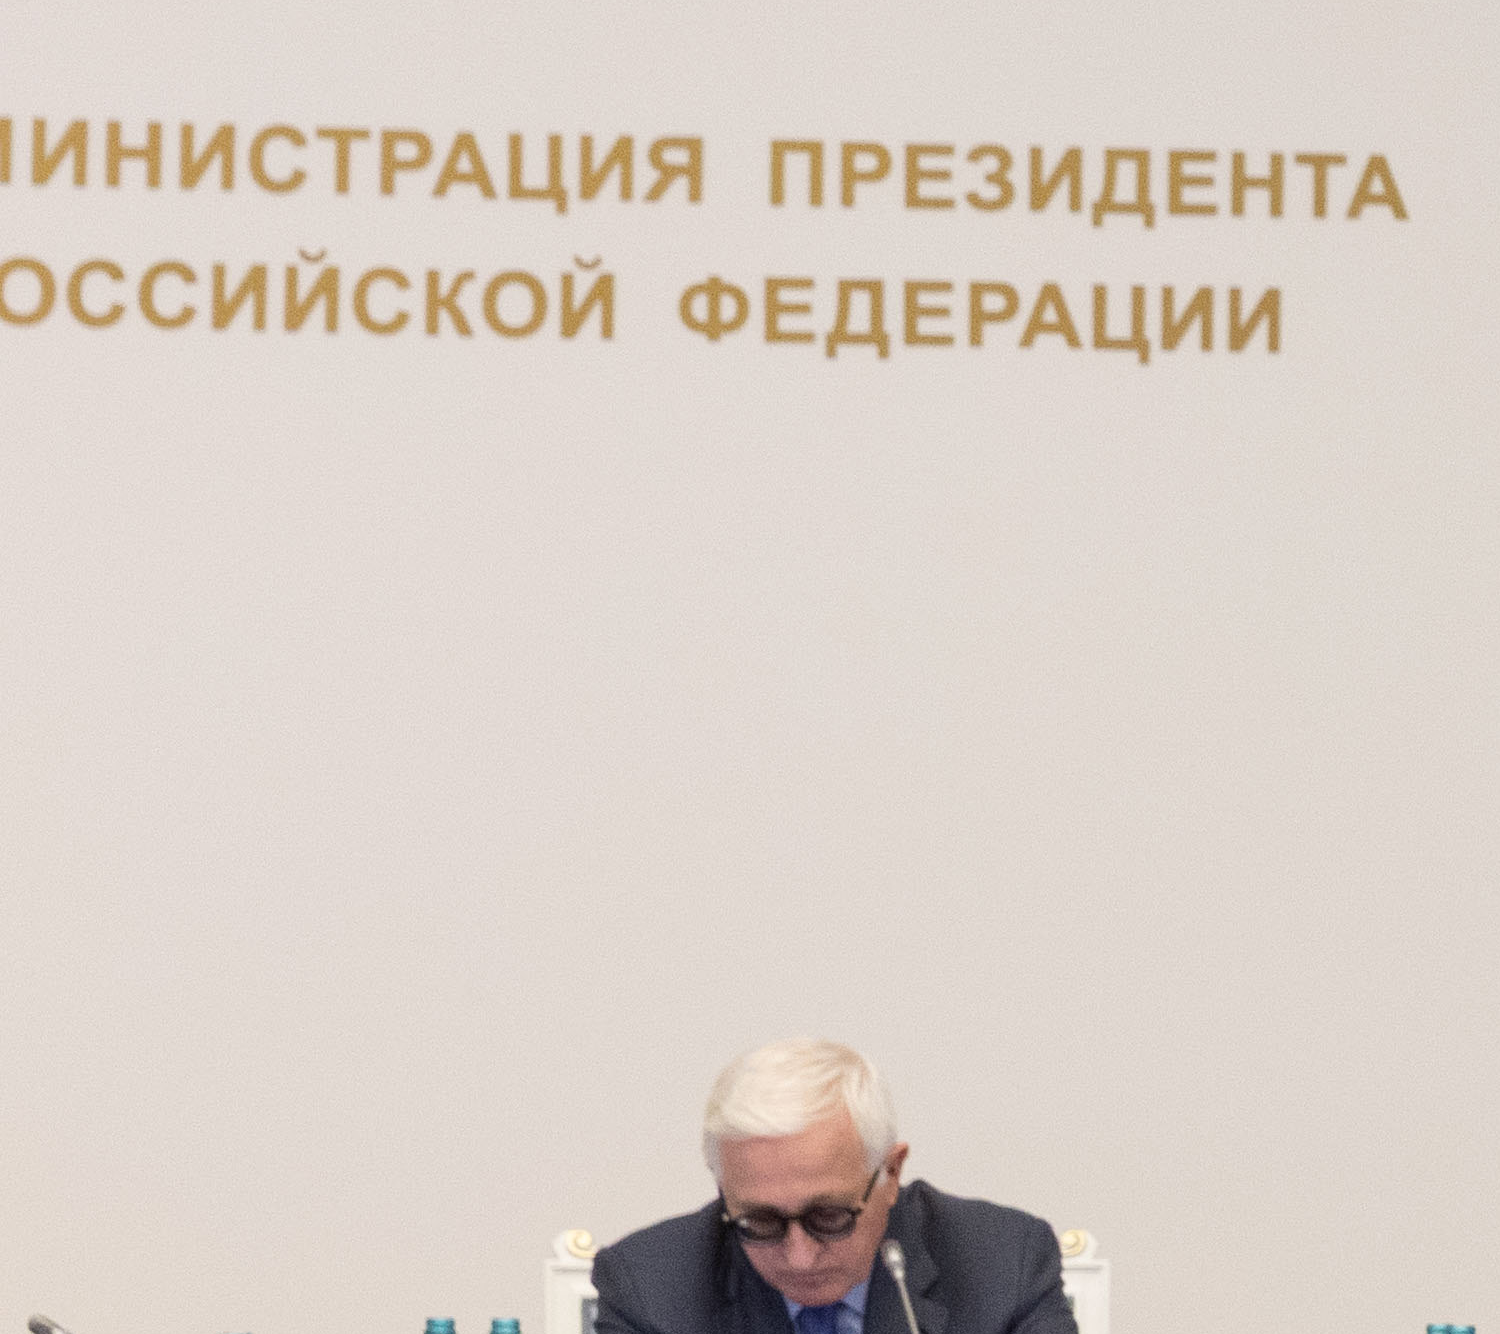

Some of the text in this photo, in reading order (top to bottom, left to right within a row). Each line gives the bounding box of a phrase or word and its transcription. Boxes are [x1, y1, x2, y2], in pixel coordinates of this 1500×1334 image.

[0, 117, 1408, 228] ИНИСТРАЦИЯ ПРЕЗИДЕНТА
[0, 249, 1282, 364] ОССИЙСКОЙ ФЕДЕРАЦИИ
